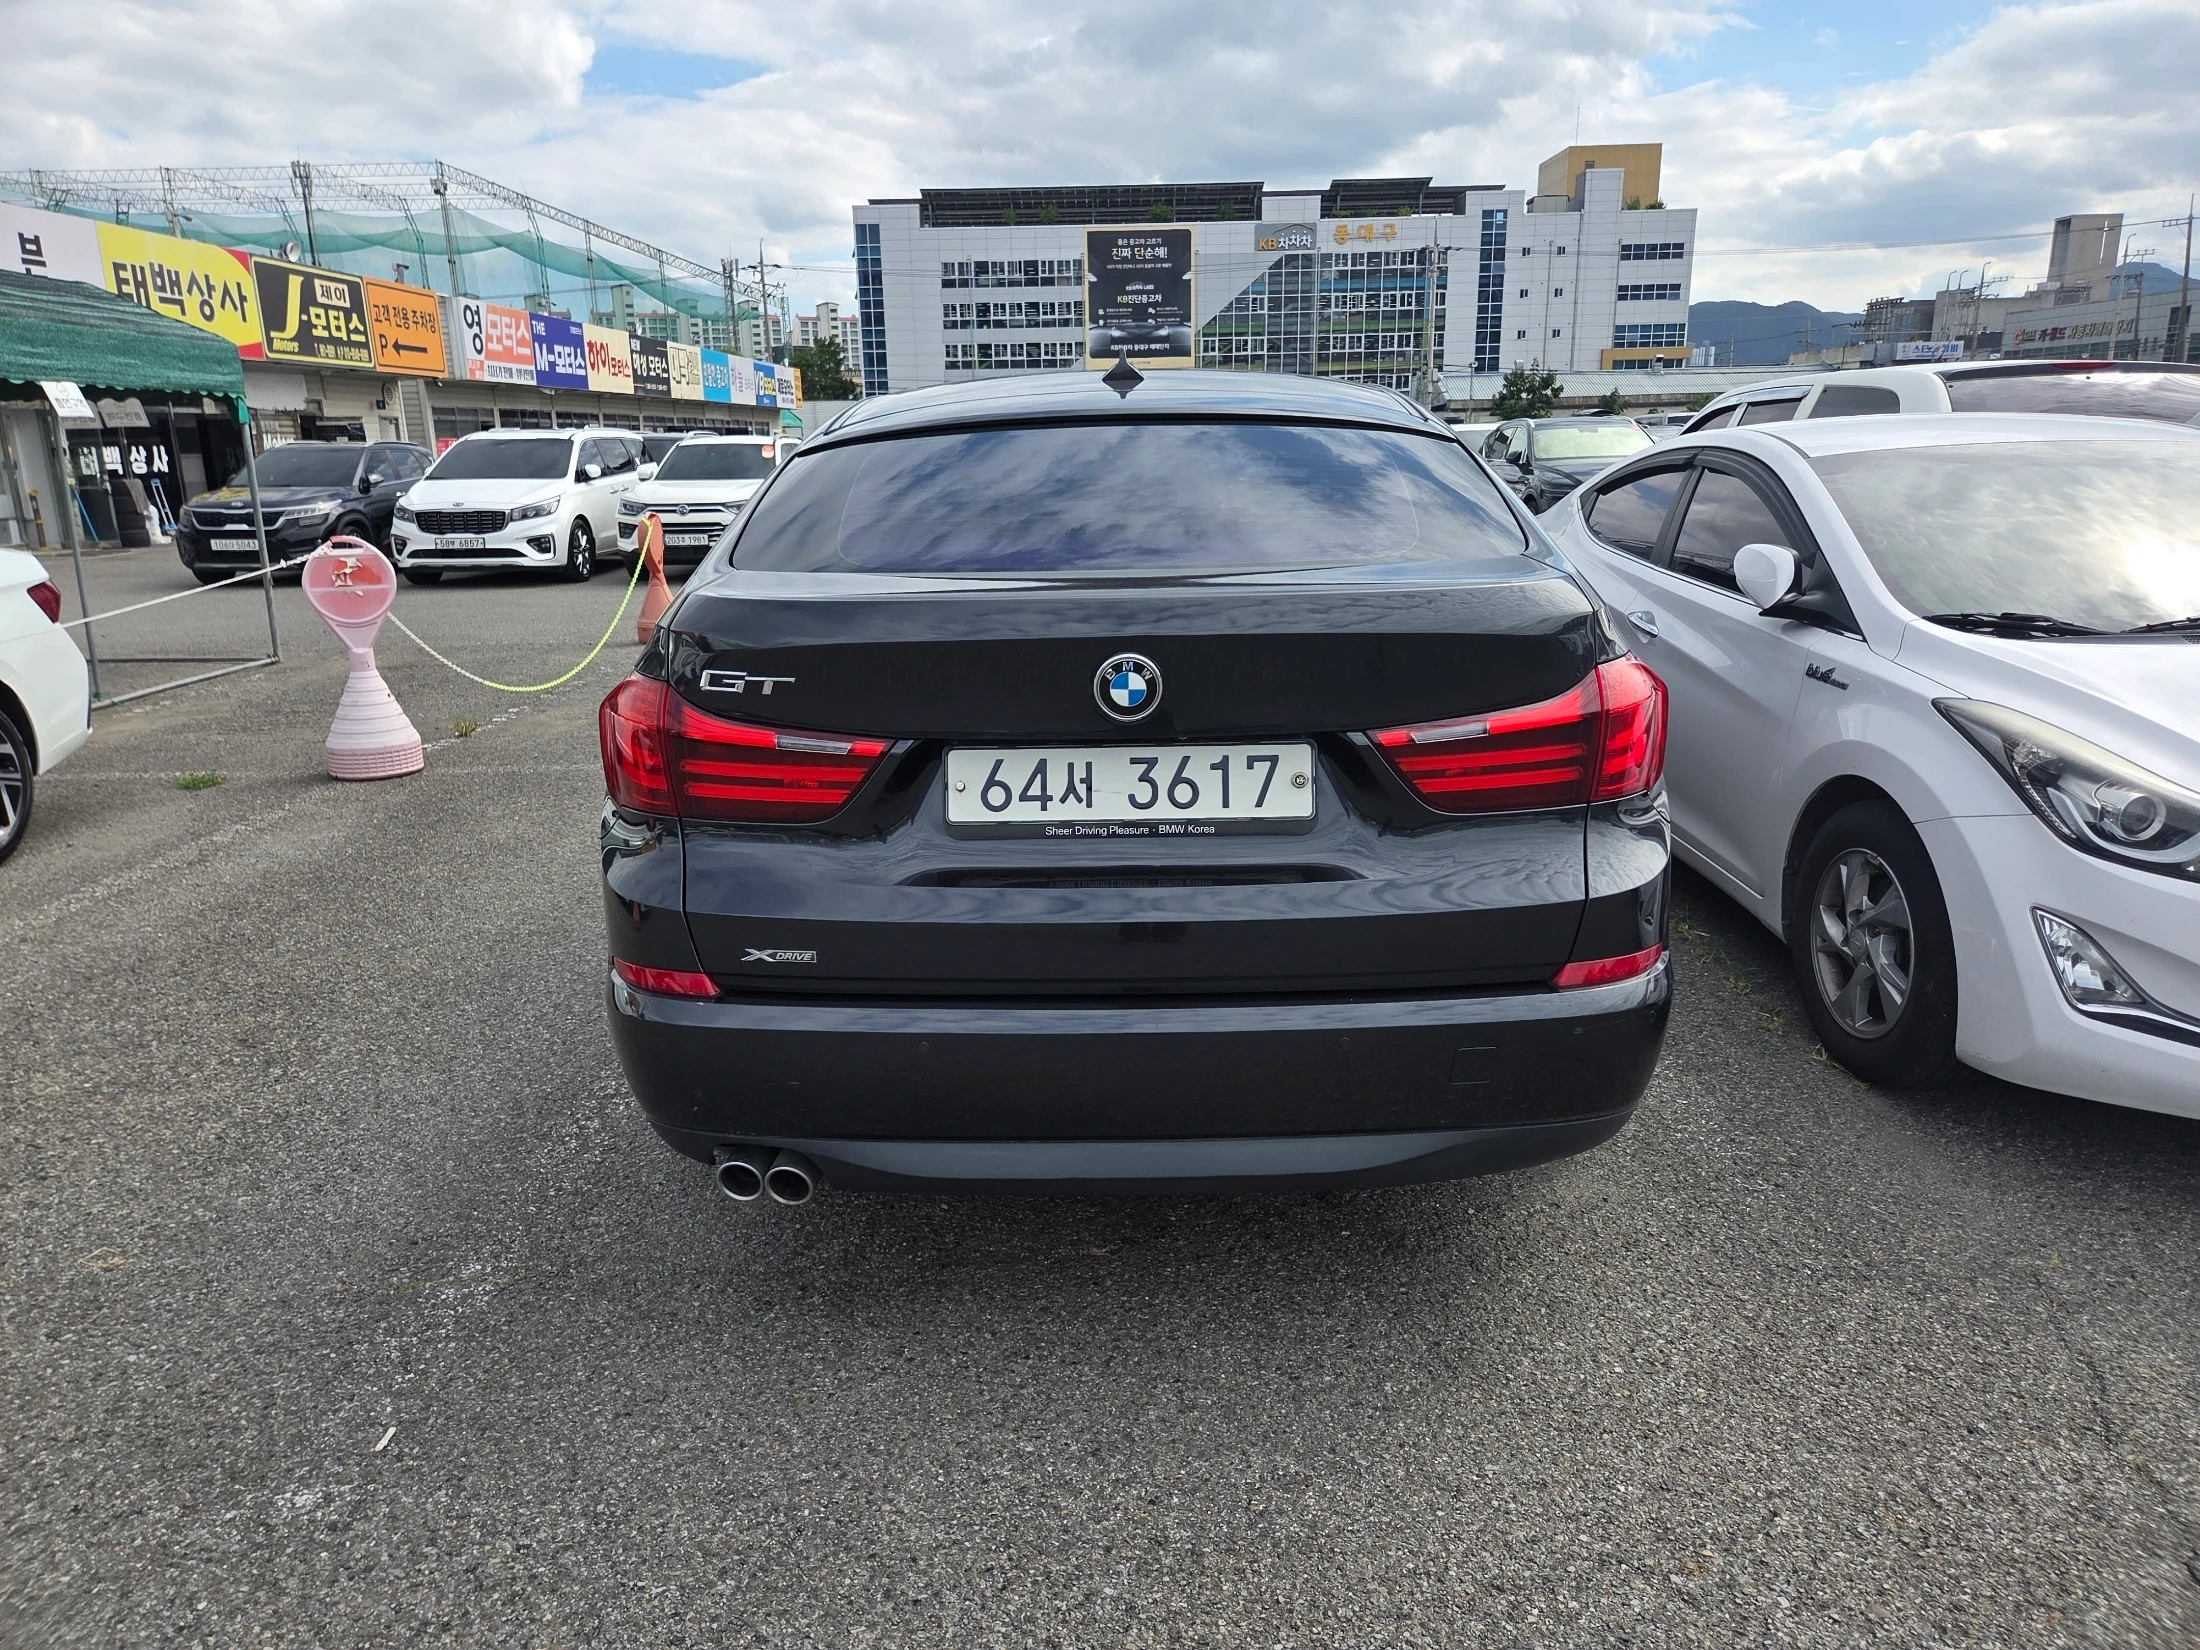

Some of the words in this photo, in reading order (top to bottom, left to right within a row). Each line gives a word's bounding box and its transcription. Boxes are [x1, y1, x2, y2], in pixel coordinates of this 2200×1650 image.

[1129, 238, 1145, 246] 중고차
[1259, 230, 1313, 250] KB차차차
[1333, 222, 1397, 245] 동대구
[1111, 248, 1132, 260] 진짜
[1134, 246, 1168, 260] 단순해!
[112, 261, 248, 323] 태백상사
[319, 284, 347, 304] 제이
[1117, 294, 1162, 304] KB진단중고차
[372, 303, 392, 327] 고객
[392, 305, 410, 330] 전용
[411, 310, 436, 334] 주차장
[532, 320, 546, 335] THE
[463, 304, 484, 355] 영
[487, 313, 531, 356] 모터스
[273, 338, 299, 353] Motors
[587, 340, 611, 377] 하이
[611, 357, 631, 378] 모터스
[648, 355, 669, 378] 모터스
[459, 539, 480, 548] 6857
[688, 536, 706, 544] 1981
[1104, 662, 1153, 680] BMW
[700, 669, 796, 695] GT
[980, 757, 1093, 812] 64서
[1128, 754, 1279, 810] 3617
[1045, 826, 1073, 836] Sheer
[1075, 826, 1107, 837] Driving
[1109, 825, 1149, 836] Pleasure
[1158, 824, 1185, 834] BMW
[1187, 824, 1215, 834] Korea
